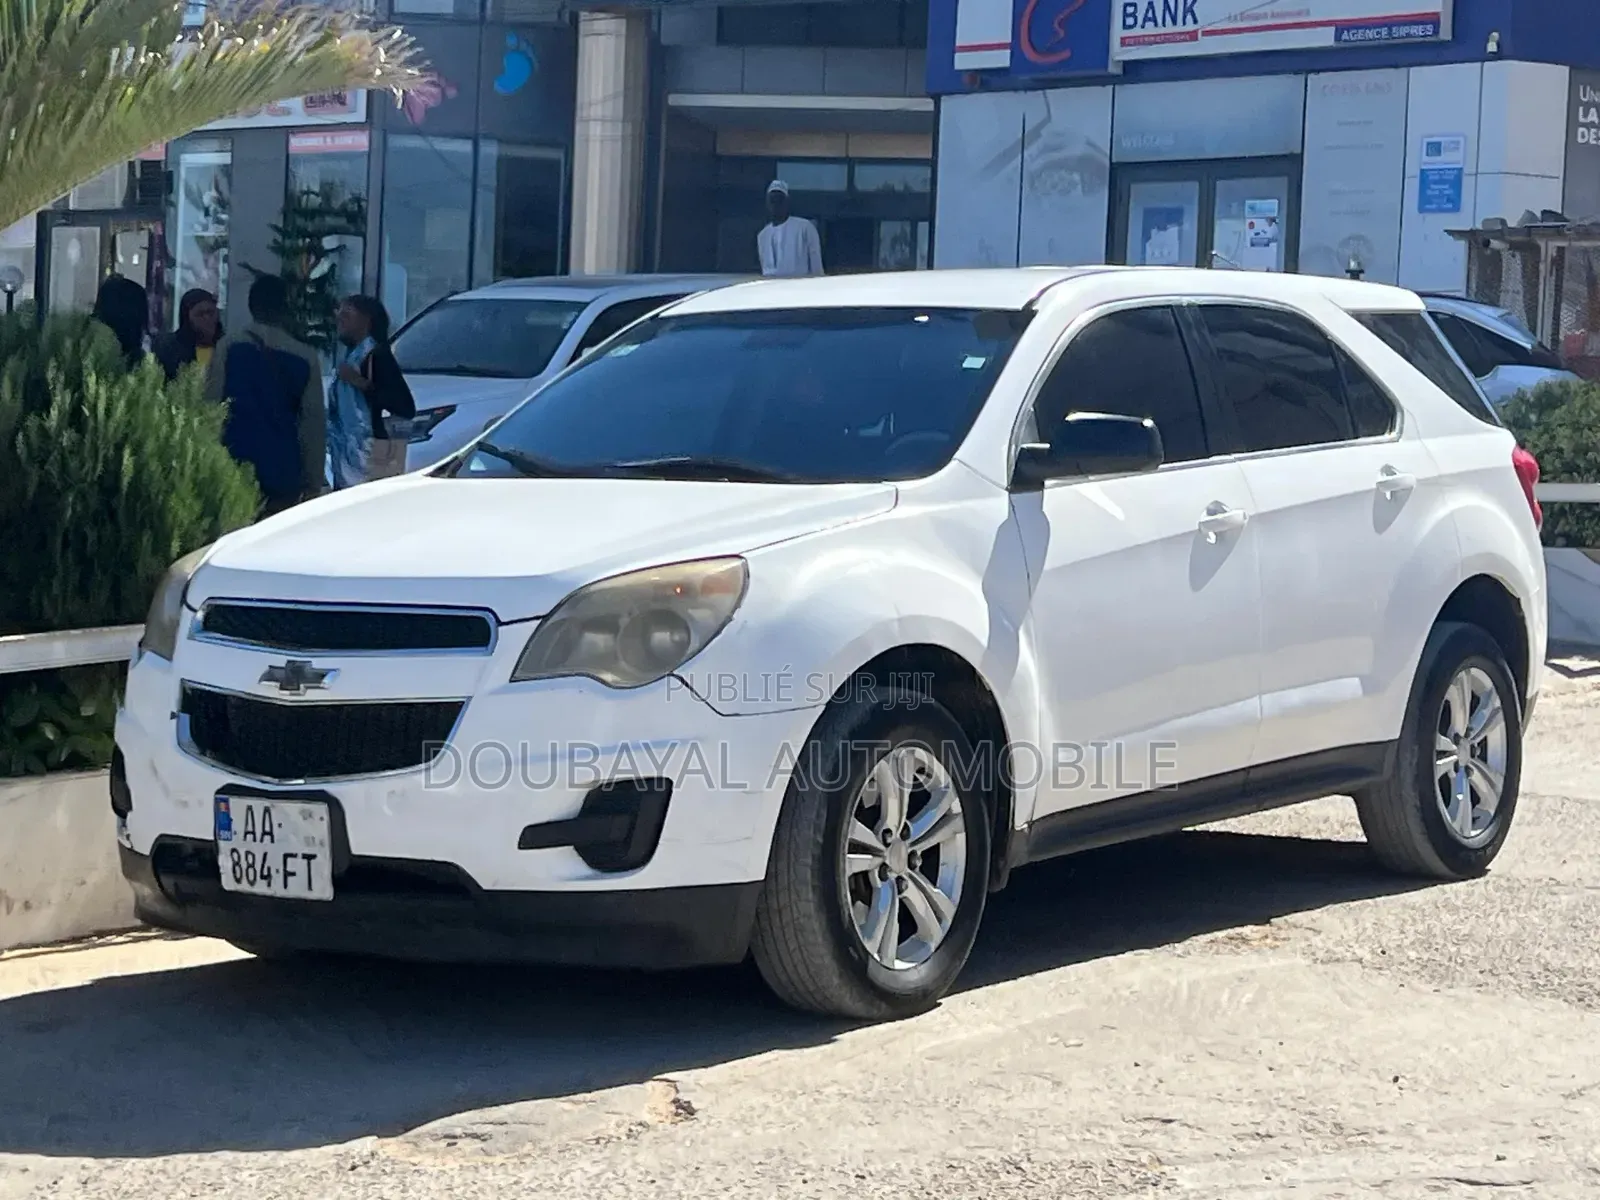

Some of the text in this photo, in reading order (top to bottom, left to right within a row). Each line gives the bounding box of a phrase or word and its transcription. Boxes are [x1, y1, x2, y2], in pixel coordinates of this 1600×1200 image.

[1122, 0, 1199, 31] BANK
[1341, 27, 1389, 41] AGENCE
[1578, 106, 1599, 125] LA
